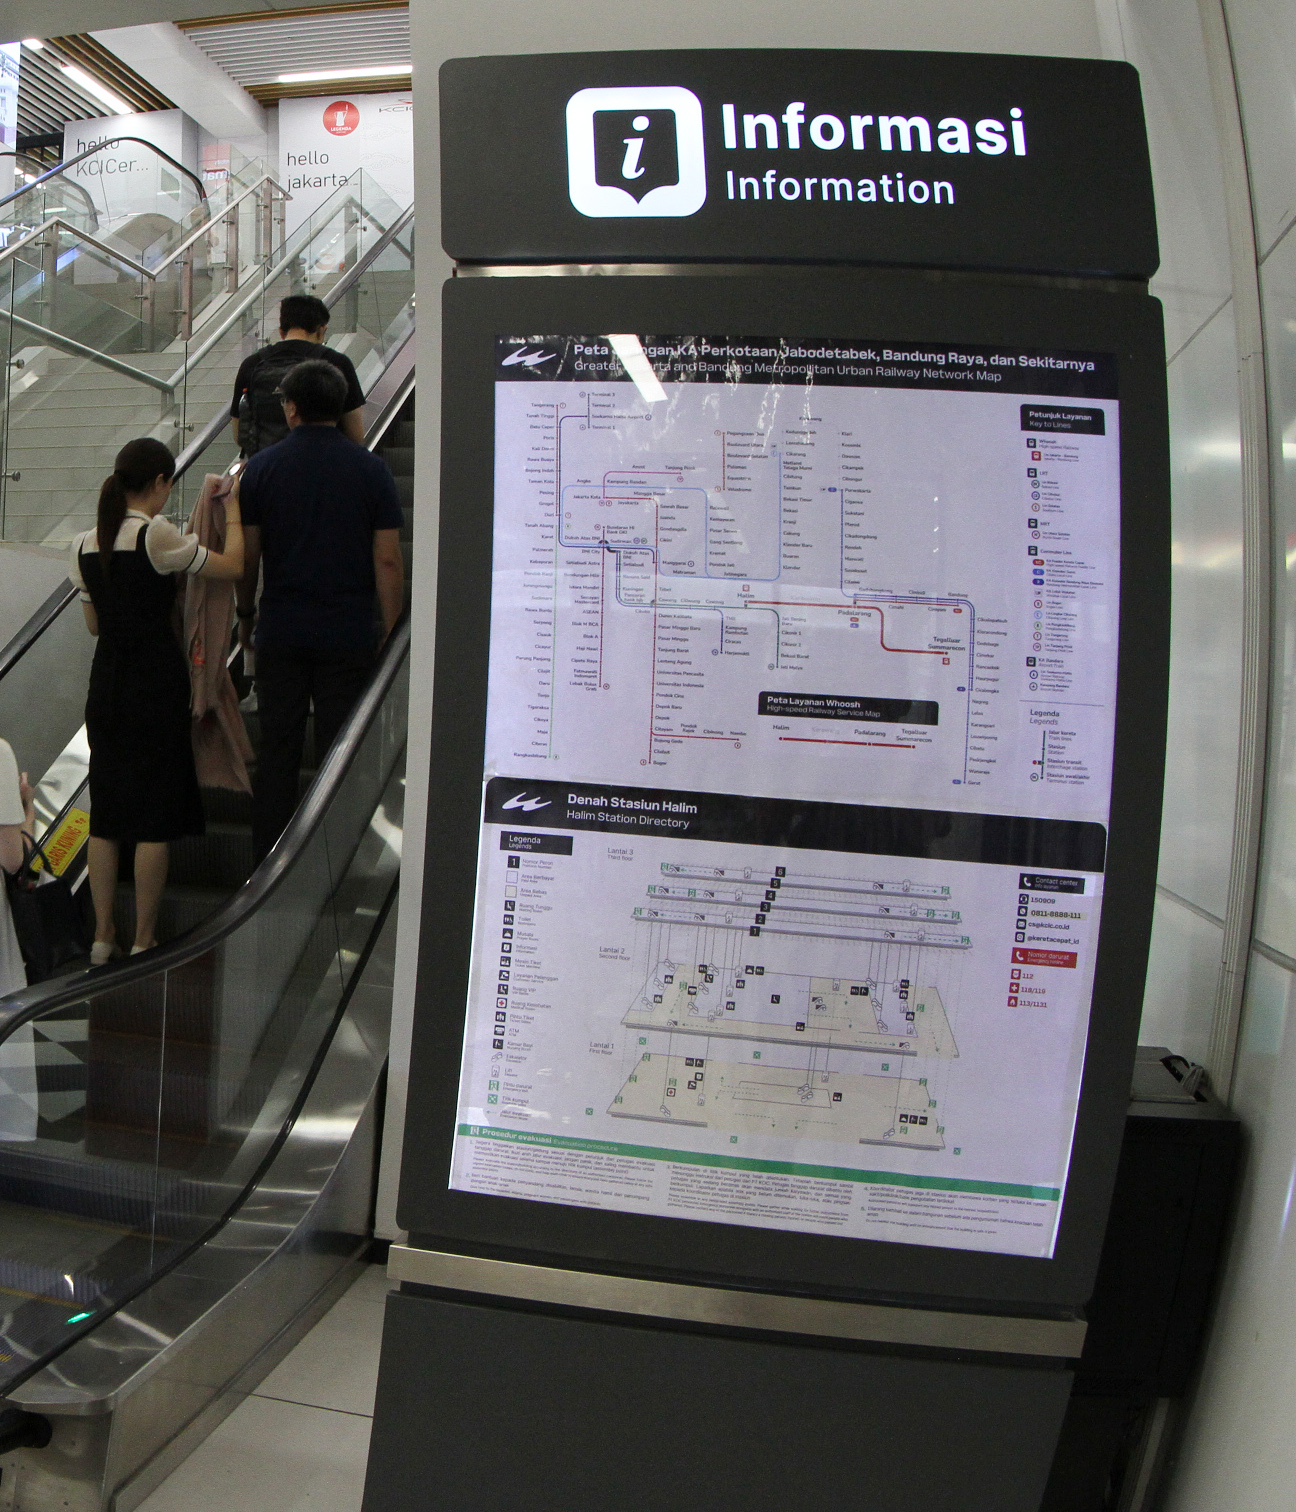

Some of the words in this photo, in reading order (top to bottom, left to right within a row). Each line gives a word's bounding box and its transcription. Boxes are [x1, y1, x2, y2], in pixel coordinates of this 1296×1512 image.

[722, 101, 1026, 156] Informasi
[77, 136, 119, 153] hello
[287, 151, 329, 166] hello
[727, 169, 954, 204] Information
[574, 345, 608, 355] Peta
[678, 345, 697, 356] KA
[702, 346, 777, 356] Perkotaan
[783, 346, 880, 361] Jabodetabek,
[883, 350, 946, 365] Bandung
[948, 352, 987, 367] Raya,
[990, 355, 1016, 366] dan
[1019, 355, 1095, 372] Sekitarnya
[575, 361, 621, 371] Greater
[673, 361, 696, 372] and
[837, 365, 873, 376] Urban
[875, 366, 920, 379] Railway
[923, 368, 974, 380] Network
[976, 371, 1002, 382] Map
[1029, 411, 1062, 419] Petunjuk
[838, 610, 871, 618] Padalarang
[768, 696, 788, 704] Peta
[789, 698, 825, 707] Layanan
[826, 700, 860, 708] Whoosh
[767, 704, 808, 714] High-speed
[808, 707, 835, 716] Railway
[865, 710, 881, 718] Map
[1030, 709, 1059, 717] Legenda
[854, 729, 886, 737] Padalarang
[568, 794, 608, 806] Denah
[611, 797, 660, 810] Stasiun
[662, 800, 698, 814] Halim
[567, 810, 596, 820] Halim
[598, 812, 637, 824] Station
[639, 815, 690, 830] Directory
[510, 835, 541, 844] Legenda
[483, 1128, 517, 1139] Prosedur
[518, 1134, 552, 1143] evakuasi
